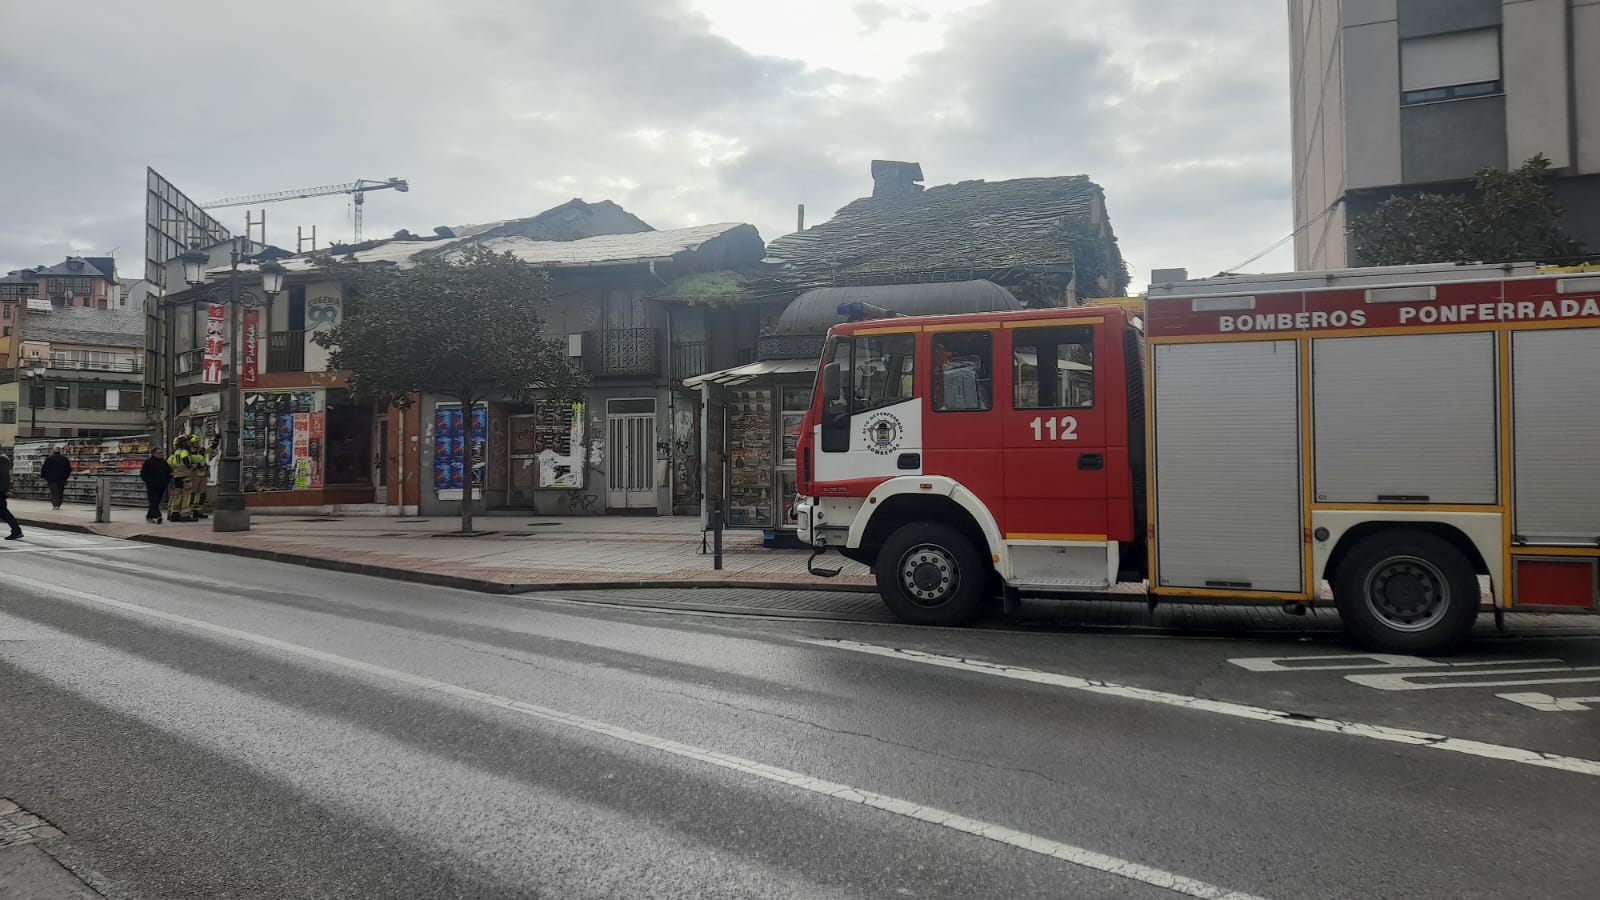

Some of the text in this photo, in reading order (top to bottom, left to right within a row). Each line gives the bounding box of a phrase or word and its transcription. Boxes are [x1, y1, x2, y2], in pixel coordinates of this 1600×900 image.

[1219, 298, 1600, 332] BOMBEROS PONFERRADA
[245, 324, 256, 382] La Puebla
[1030, 415, 1078, 441] 112
